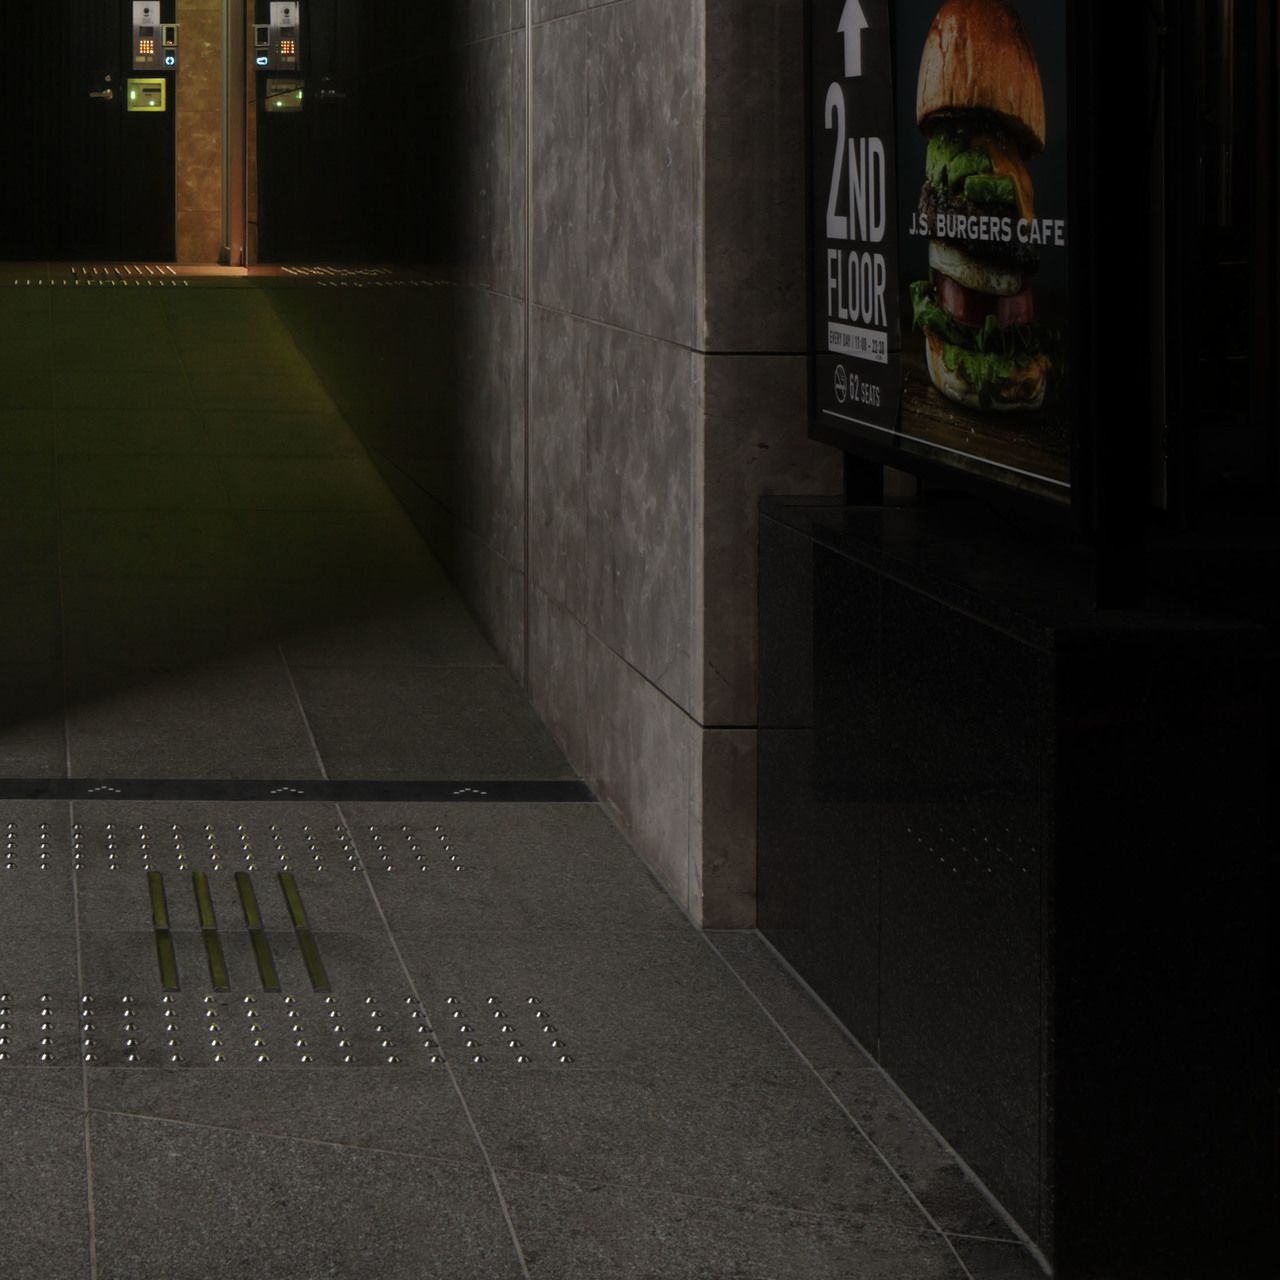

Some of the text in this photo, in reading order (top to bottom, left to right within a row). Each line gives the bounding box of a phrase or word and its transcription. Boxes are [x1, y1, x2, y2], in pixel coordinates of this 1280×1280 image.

[824, 80, 887, 244] 2ND
[908, 211, 1066, 247] J.S. BURGERS CAFE
[827, 247, 888, 328] FLOOR
[849, 372, 880, 408] 62 SEATS
